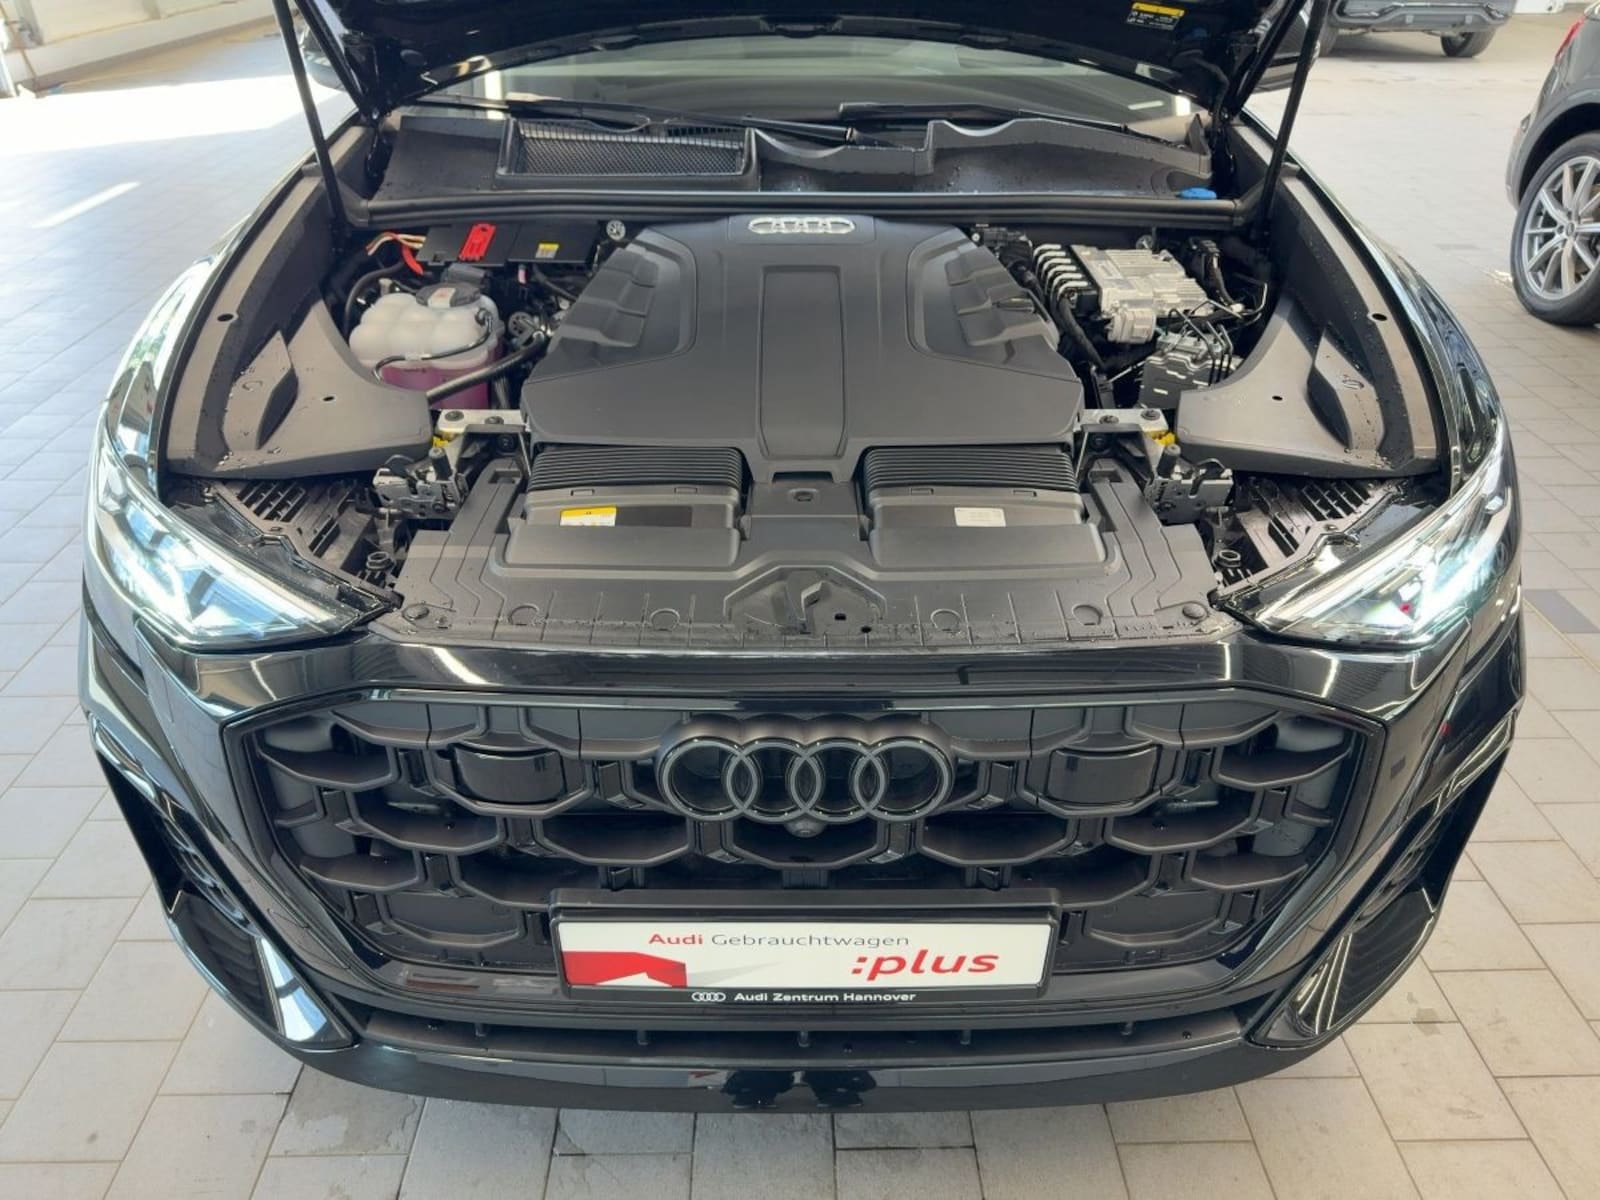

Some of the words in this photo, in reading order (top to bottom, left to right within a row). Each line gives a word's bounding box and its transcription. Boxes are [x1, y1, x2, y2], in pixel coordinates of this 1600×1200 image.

[648, 934, 704, 945] Audi
[711, 934, 910, 949] Gebrauchtwagen
[851, 949, 999, 981] :plus
[734, 992, 768, 1001] Audi
[773, 992, 839, 1002] Zentrum
[843, 992, 916, 1002] Hannover
